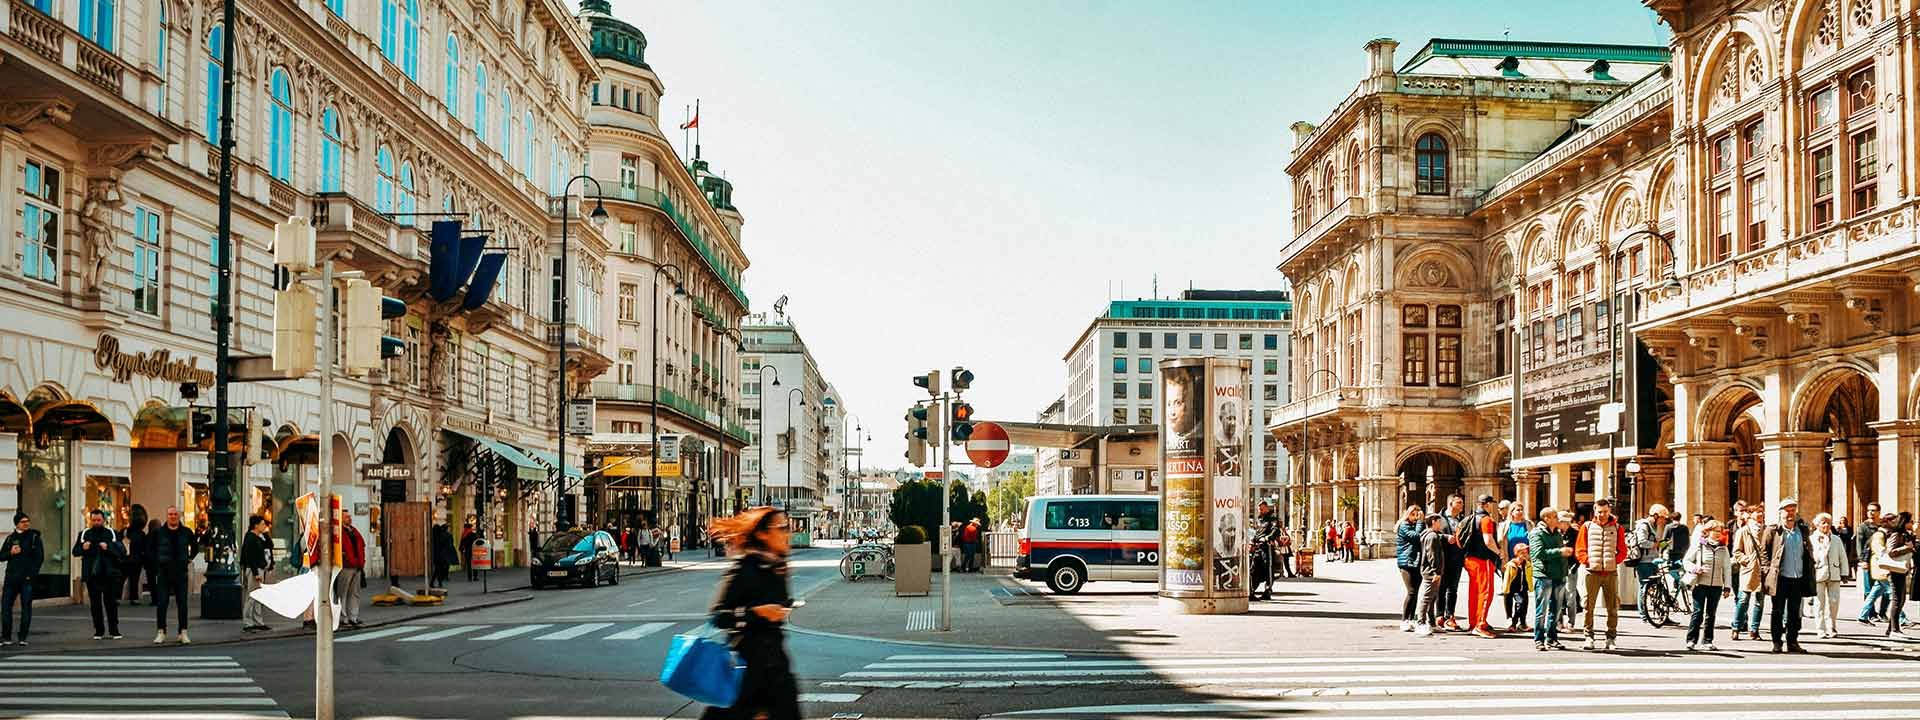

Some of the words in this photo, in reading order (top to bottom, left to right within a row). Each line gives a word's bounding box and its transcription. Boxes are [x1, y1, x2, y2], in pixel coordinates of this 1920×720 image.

[367, 465, 411, 478] AIRFIELD
[1074, 518, 1090, 527] 133
[854, 563, 863, 573] P
